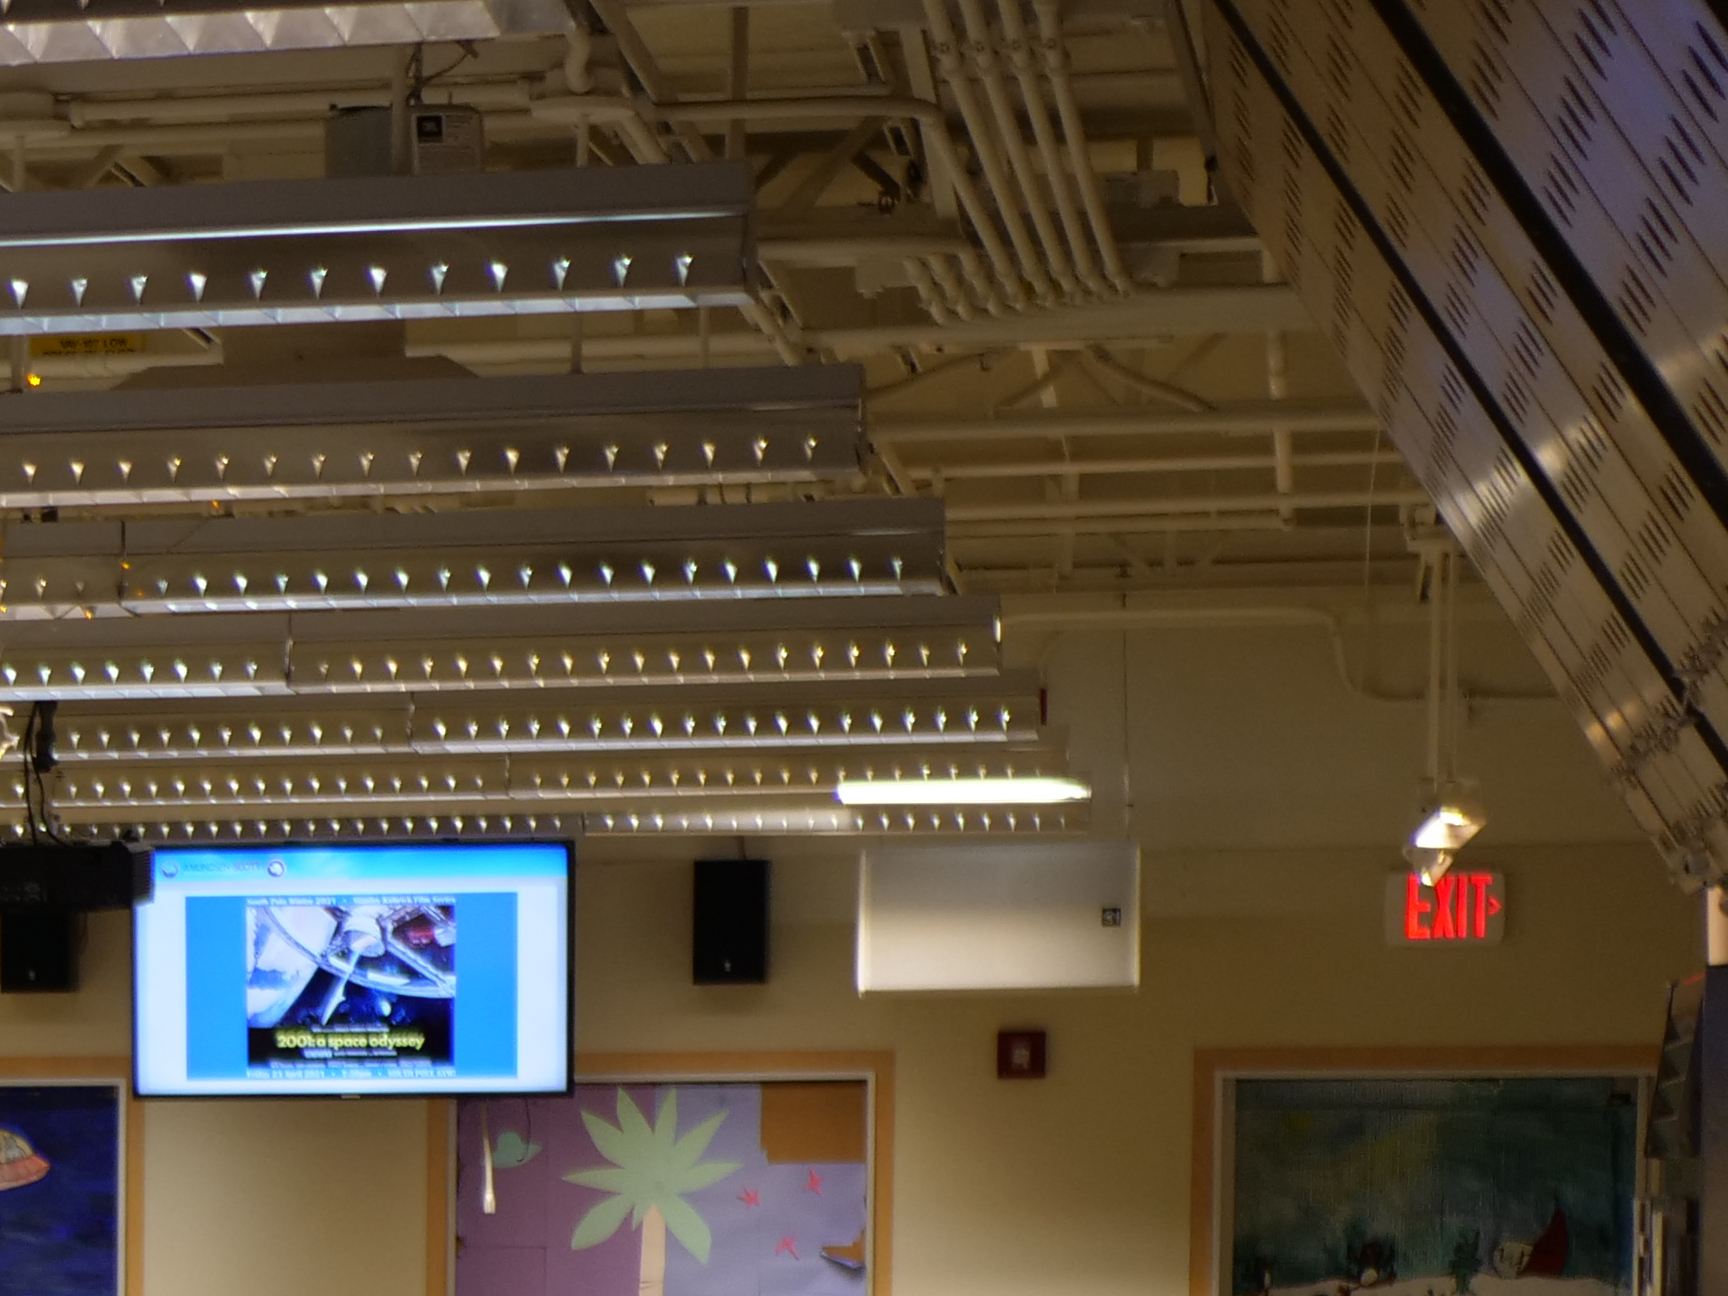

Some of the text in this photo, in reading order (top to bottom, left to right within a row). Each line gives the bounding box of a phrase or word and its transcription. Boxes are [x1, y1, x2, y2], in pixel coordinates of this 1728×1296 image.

[1405, 872, 1493, 940] EXIT
[327, 1036, 367, 1050] space
[369, 1033, 425, 1050] odyssey
